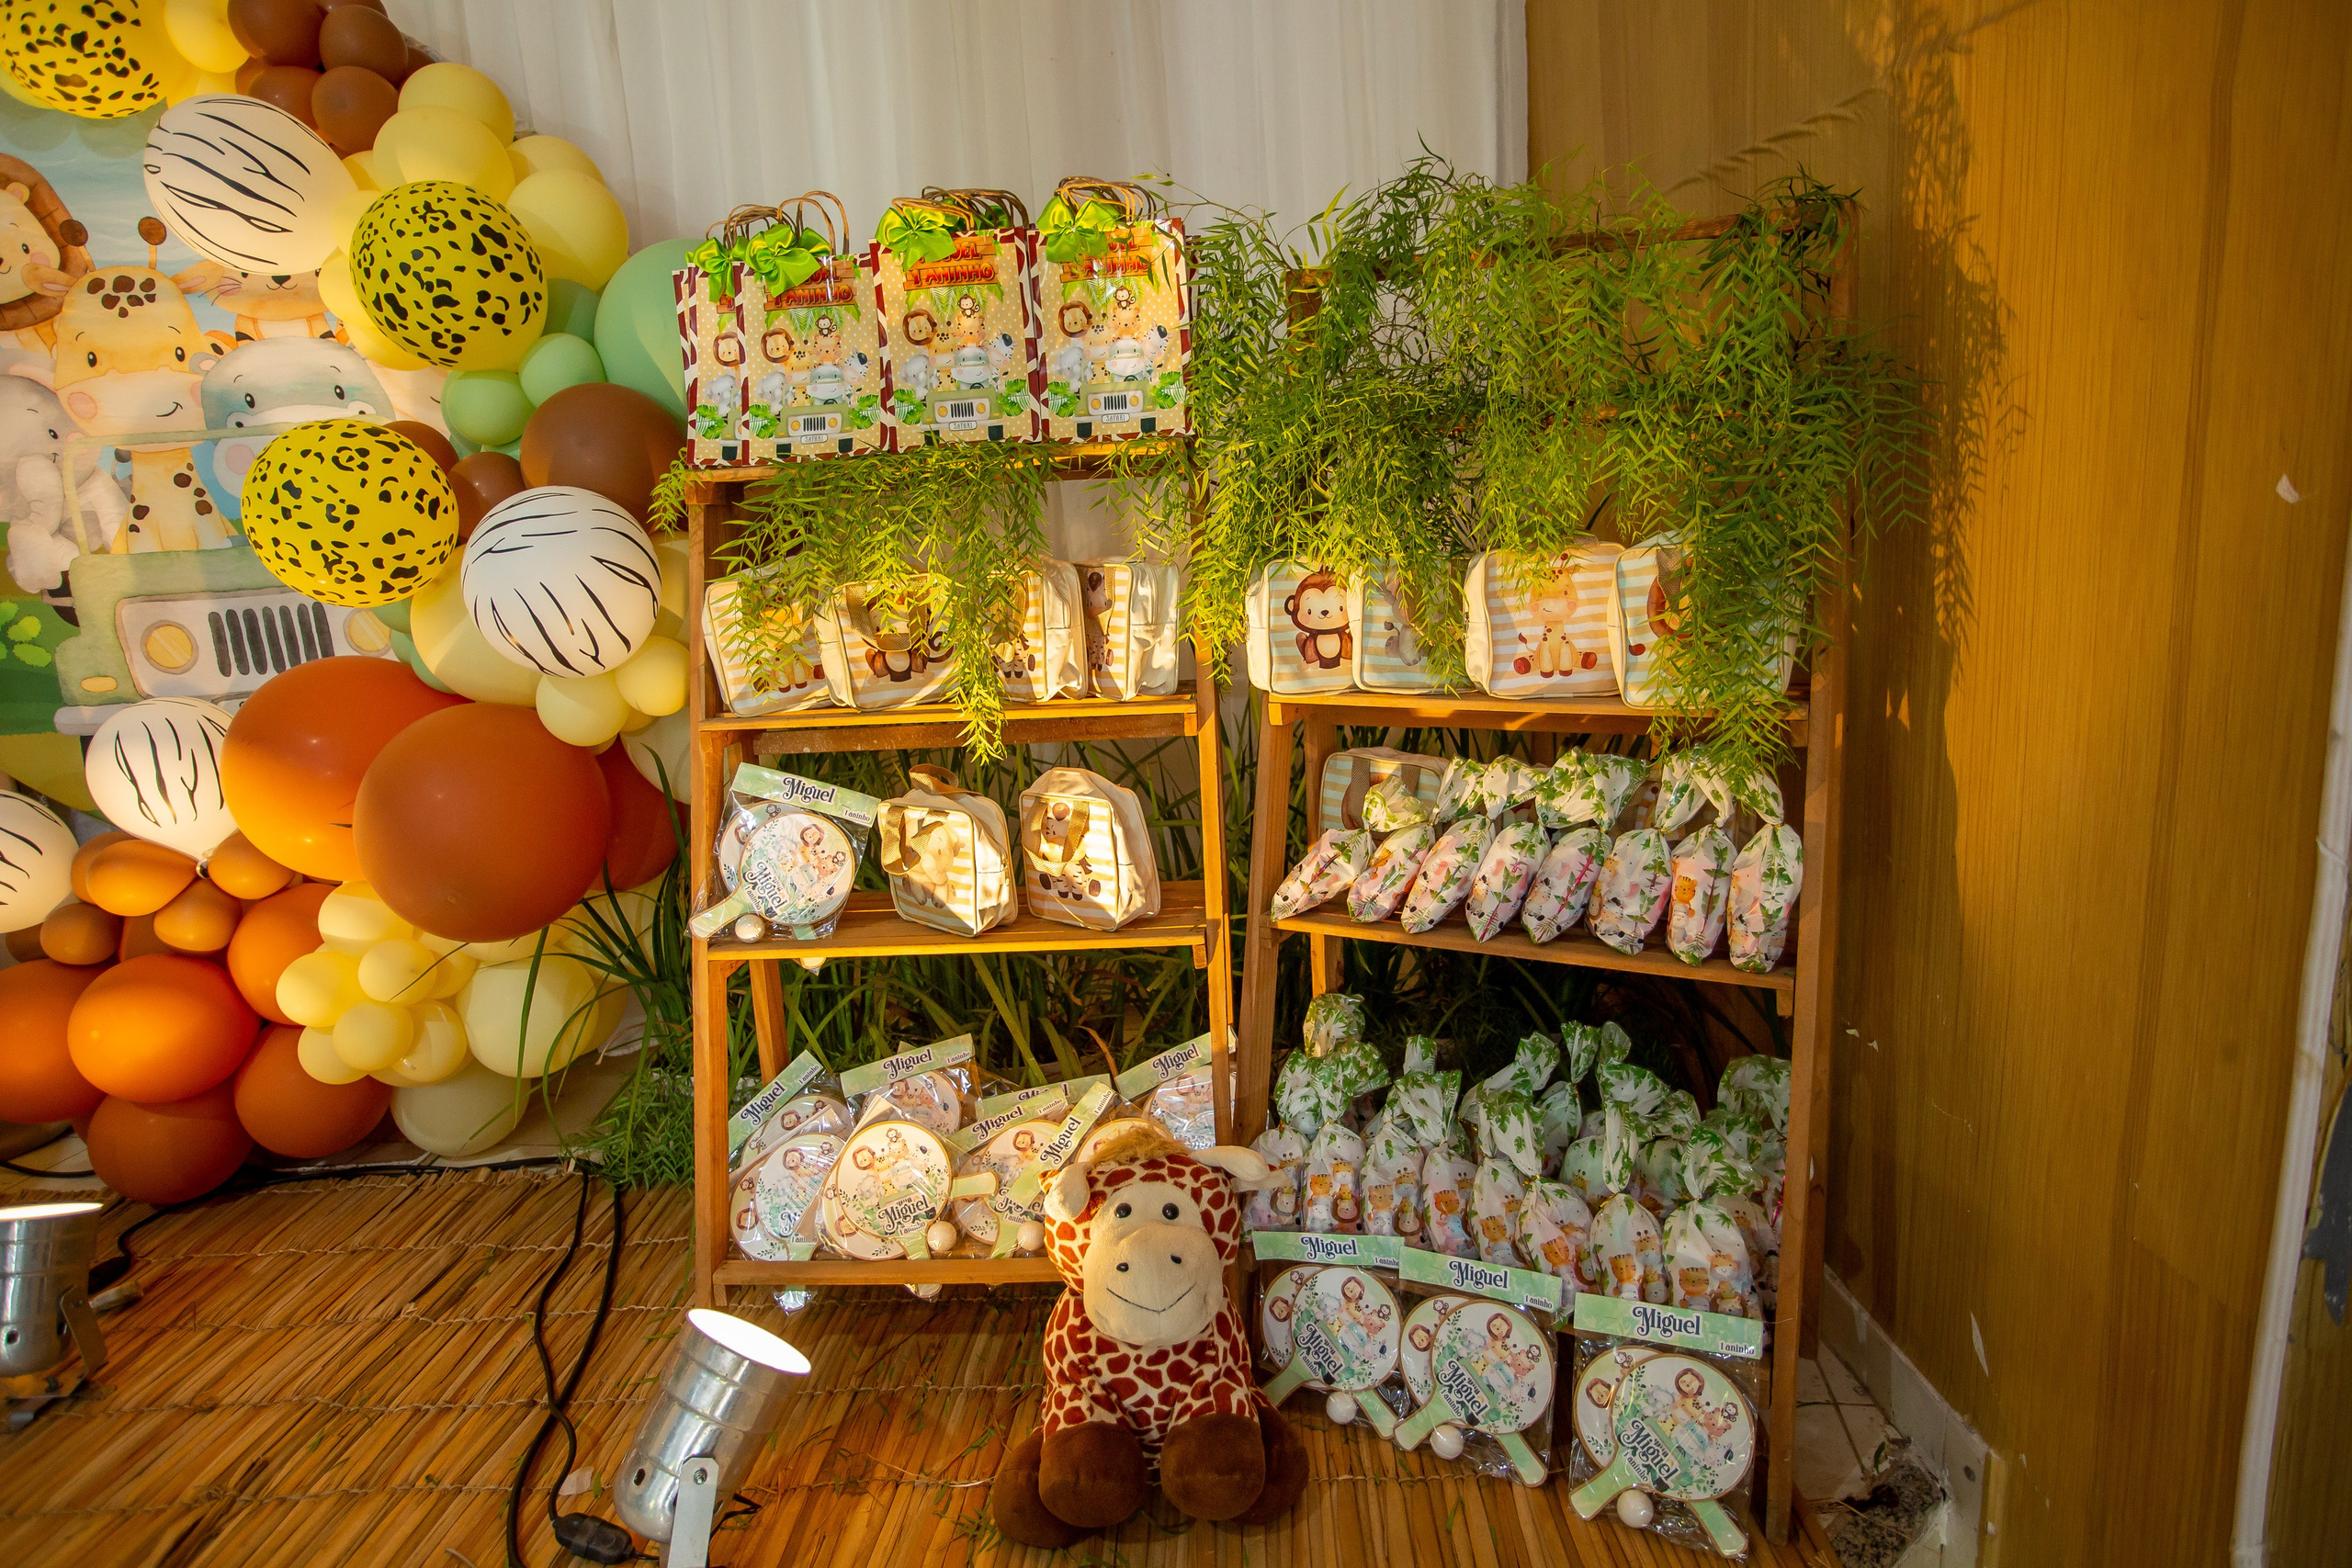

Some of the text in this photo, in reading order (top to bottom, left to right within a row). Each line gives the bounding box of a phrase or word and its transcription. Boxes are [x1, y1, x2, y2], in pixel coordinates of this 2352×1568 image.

[925, 263, 995, 285] ANINHO
[782, 776, 836, 804] Miguel
[848, 811, 871, 822] aninho
[746, 862, 788, 909] Miguel
[884, 1048, 933, 1079] Miguel
[951, 1052, 970, 1063] aninho
[1153, 1043, 1200, 1078] Miguel
[802, 1065, 820, 1082] aninho
[741, 1081, 786, 1126] Miguel
[1042, 1098, 1063, 1112] aninho
[1096, 1090, 1112, 1111] aninho
[972, 1105, 1023, 1140] Miguel
[1039, 1116, 1082, 1165] Miguel
[877, 1194, 930, 1232] Miguel
[1300, 1236, 1358, 1260] Miguel
[1449, 1260, 1509, 1290] Miguel
[1529, 1296, 1553, 1309] aninho
[1632, 1306, 1701, 1338] Miguel
[1298, 1323, 1344, 1375] Miguel
[1302, 1356, 1319, 1377] aninho
[1440, 1359, 1488, 1416] Miguel
[1443, 1393, 1463, 1417] aninho
[1622, 1419, 1679, 1481] Miguel
